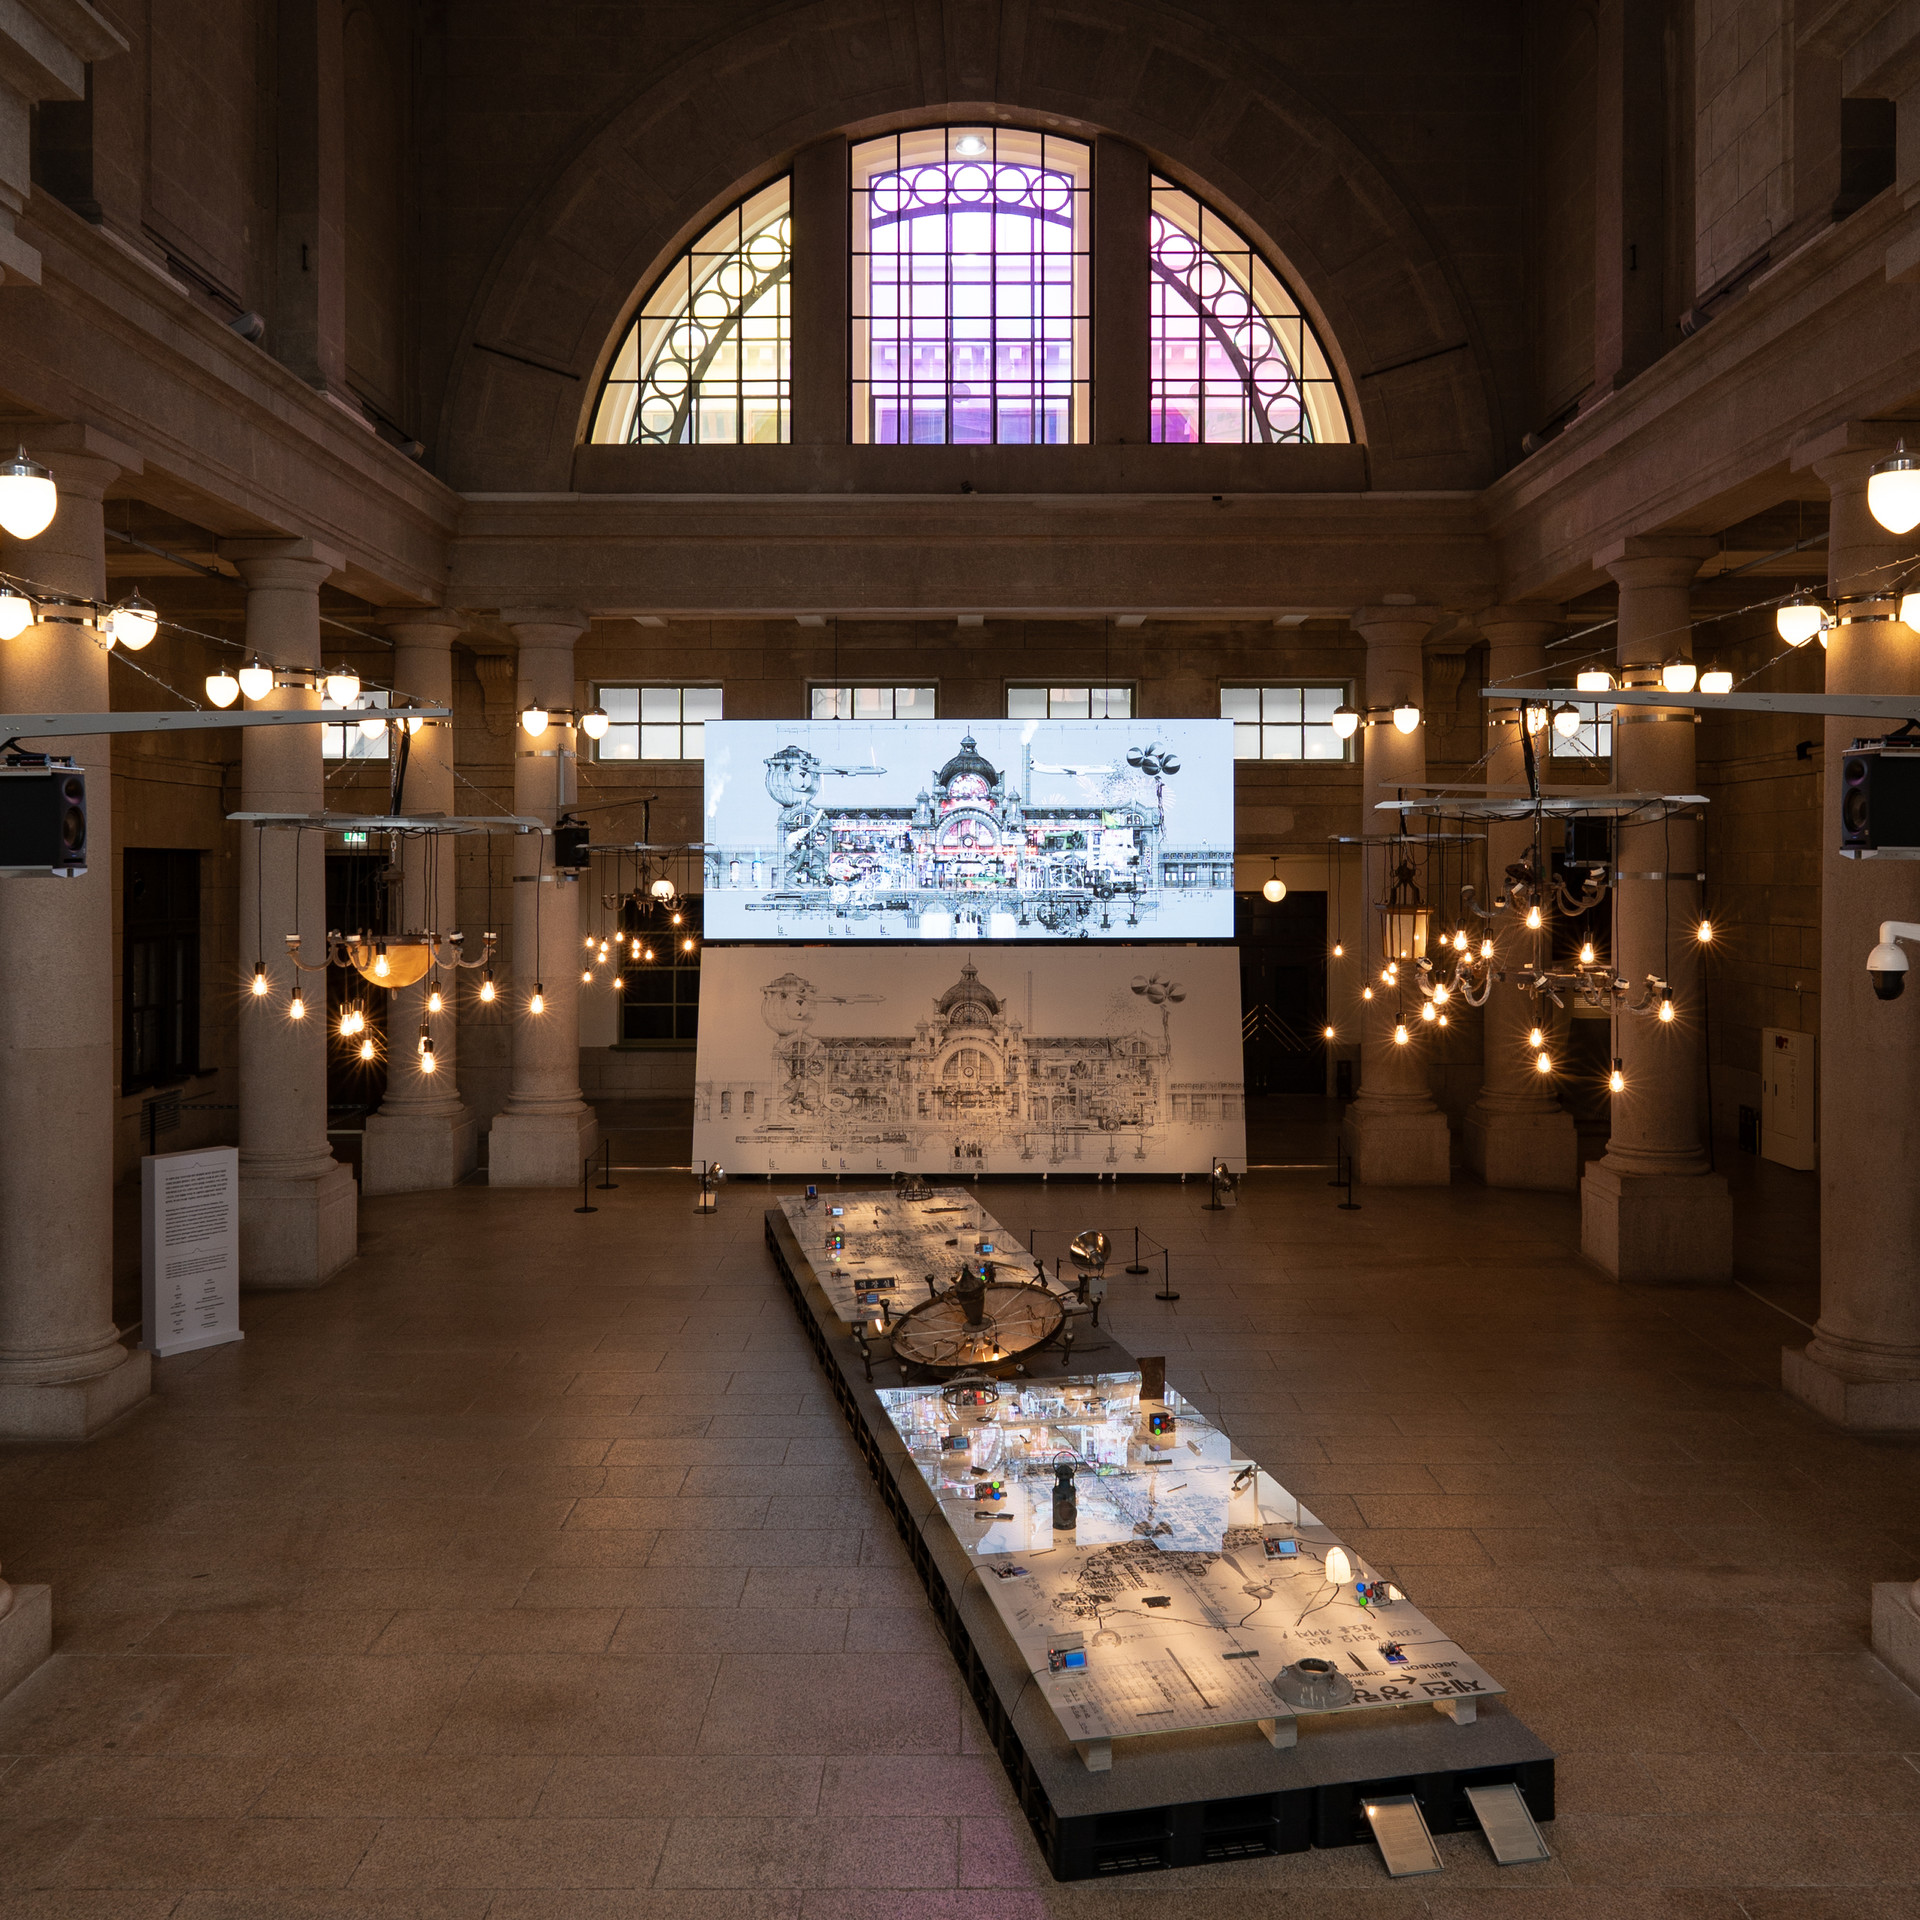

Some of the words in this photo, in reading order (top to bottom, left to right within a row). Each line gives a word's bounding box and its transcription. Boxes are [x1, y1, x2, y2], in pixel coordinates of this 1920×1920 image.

[1401, 1661, 1459, 1672] Jecheon
[1343, 1670, 1386, 1679] Cheong
[1419, 1678, 1487, 1696] 제천
[1346, 1685, 1414, 1704] 청량
